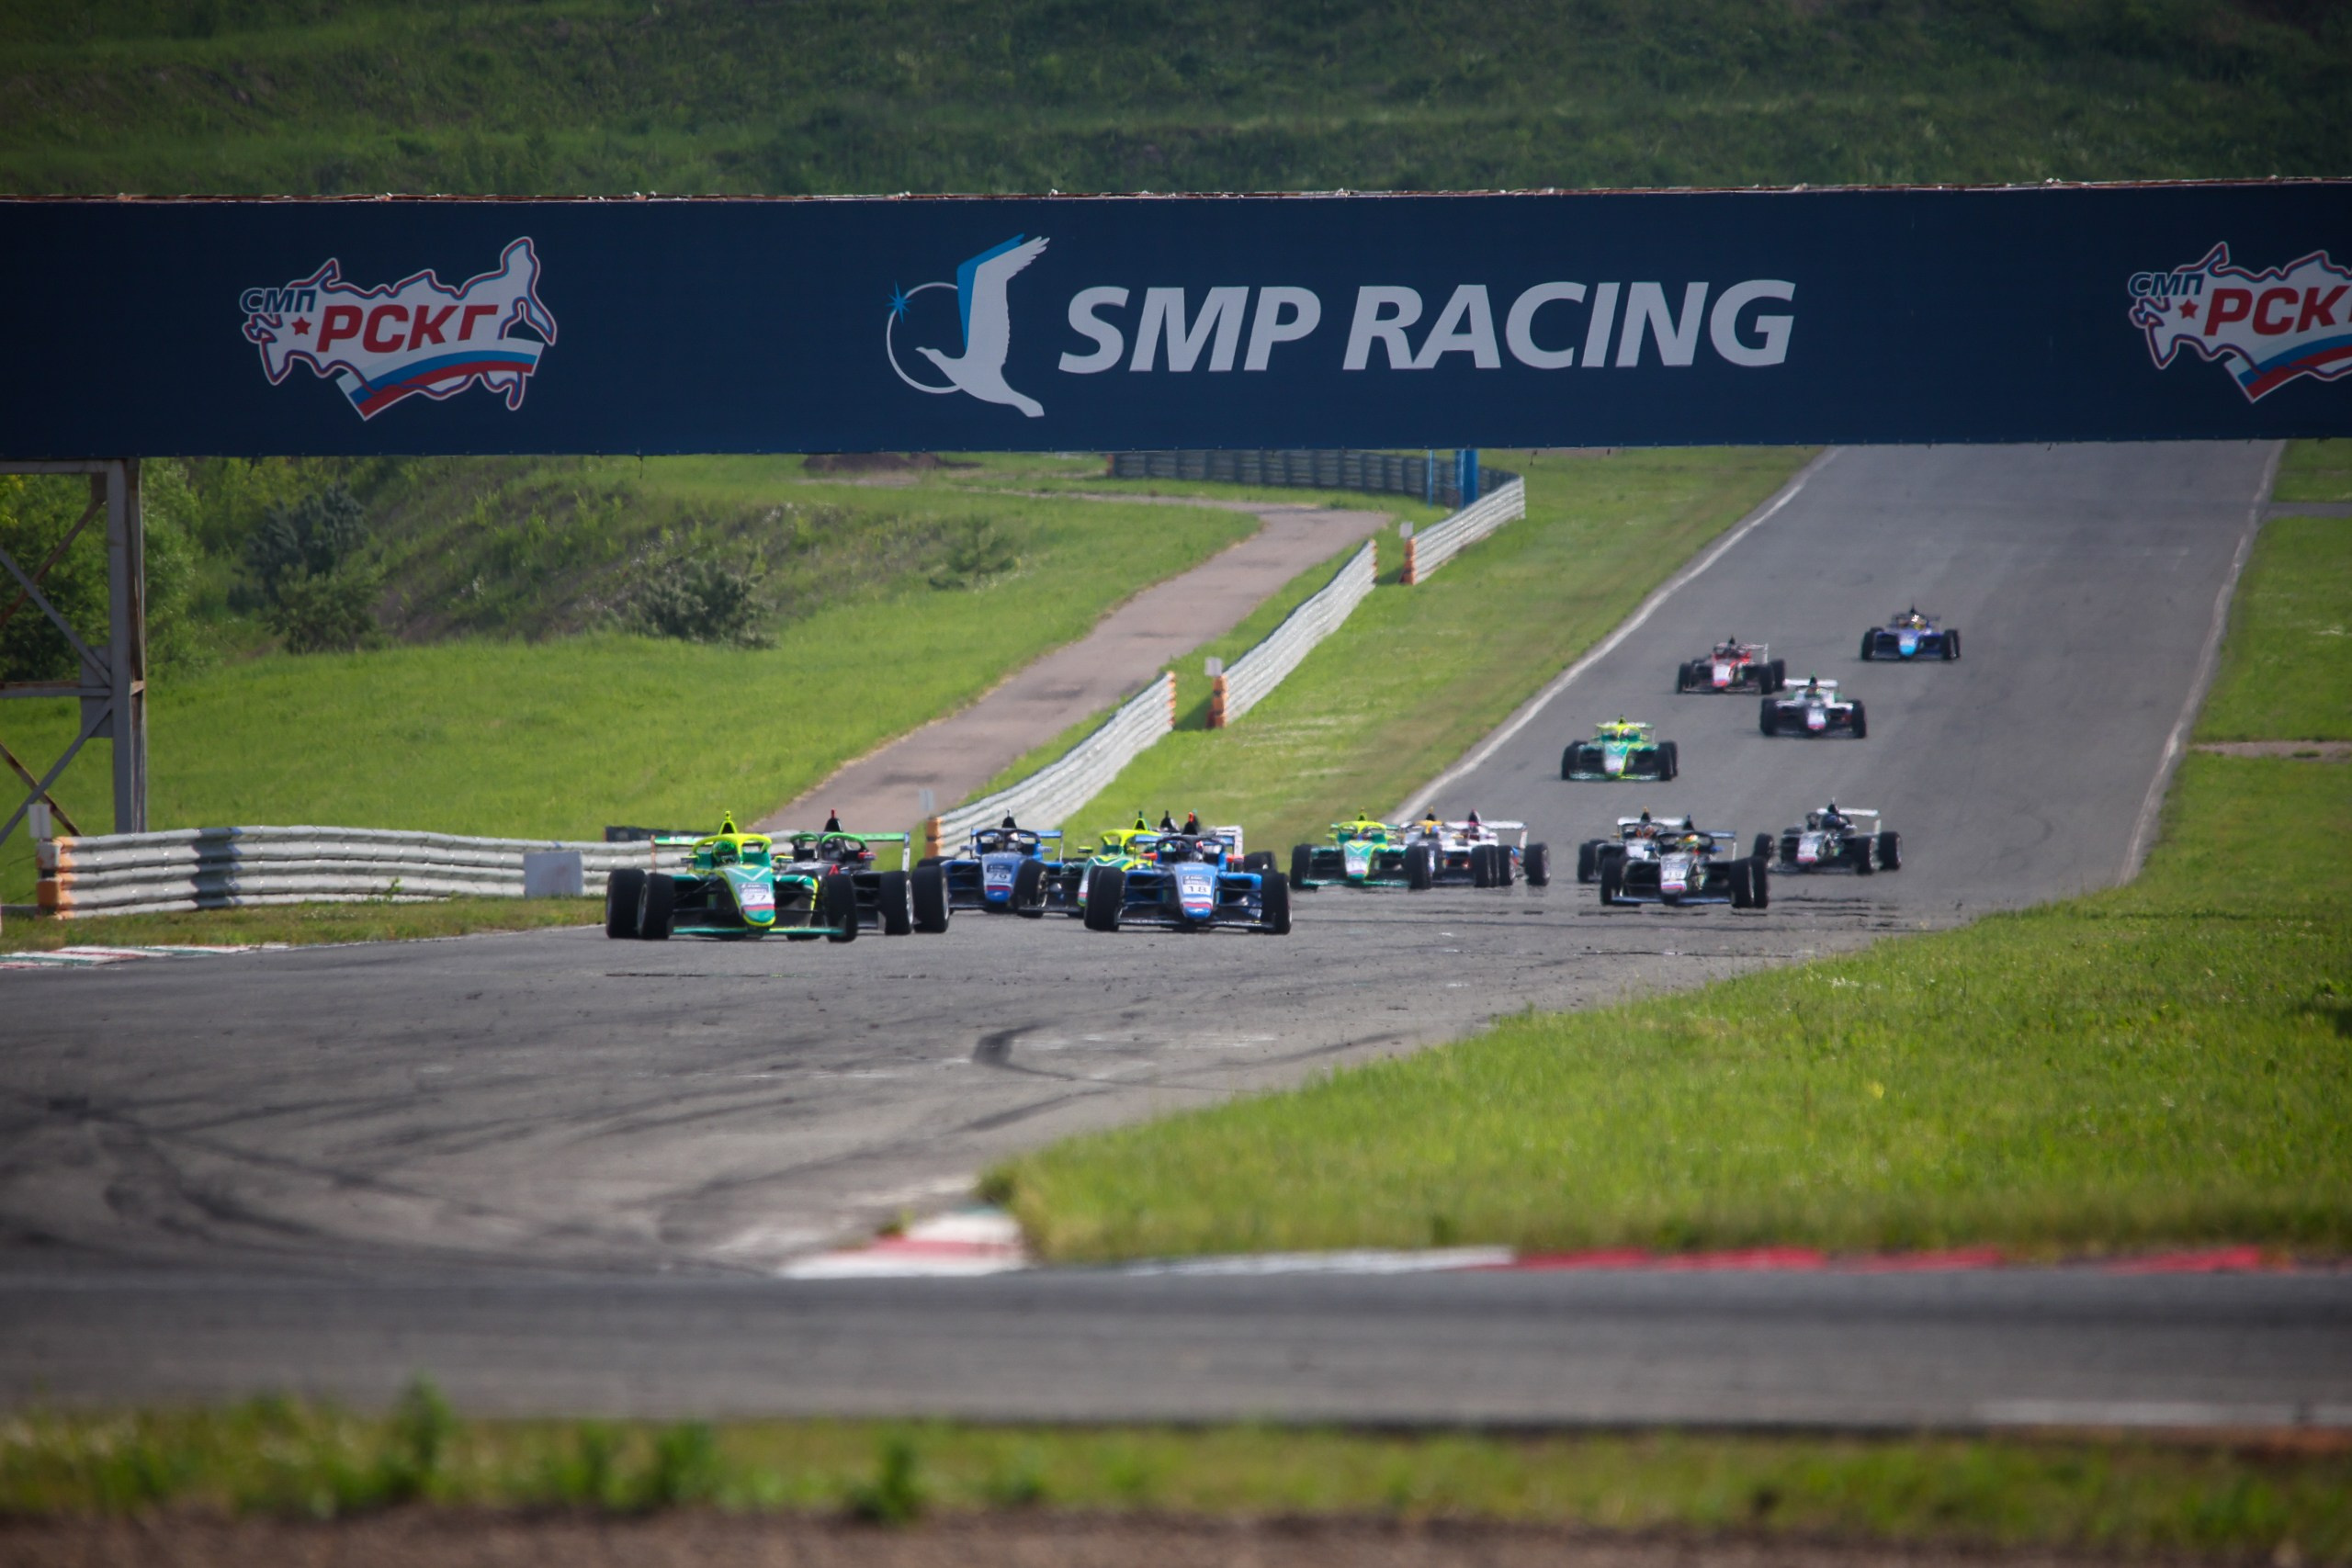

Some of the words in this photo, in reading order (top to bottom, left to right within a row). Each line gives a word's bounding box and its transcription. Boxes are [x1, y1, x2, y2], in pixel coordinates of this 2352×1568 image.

[240, 287, 317, 314] СМП
[2128, 272, 2205, 298] СМП
[316, 304, 499, 353] РСКГ
[1058, 284, 1321, 373] SMP
[1342, 278, 1795, 371] RACING
[2203, 285, 2352, 336] РСК
